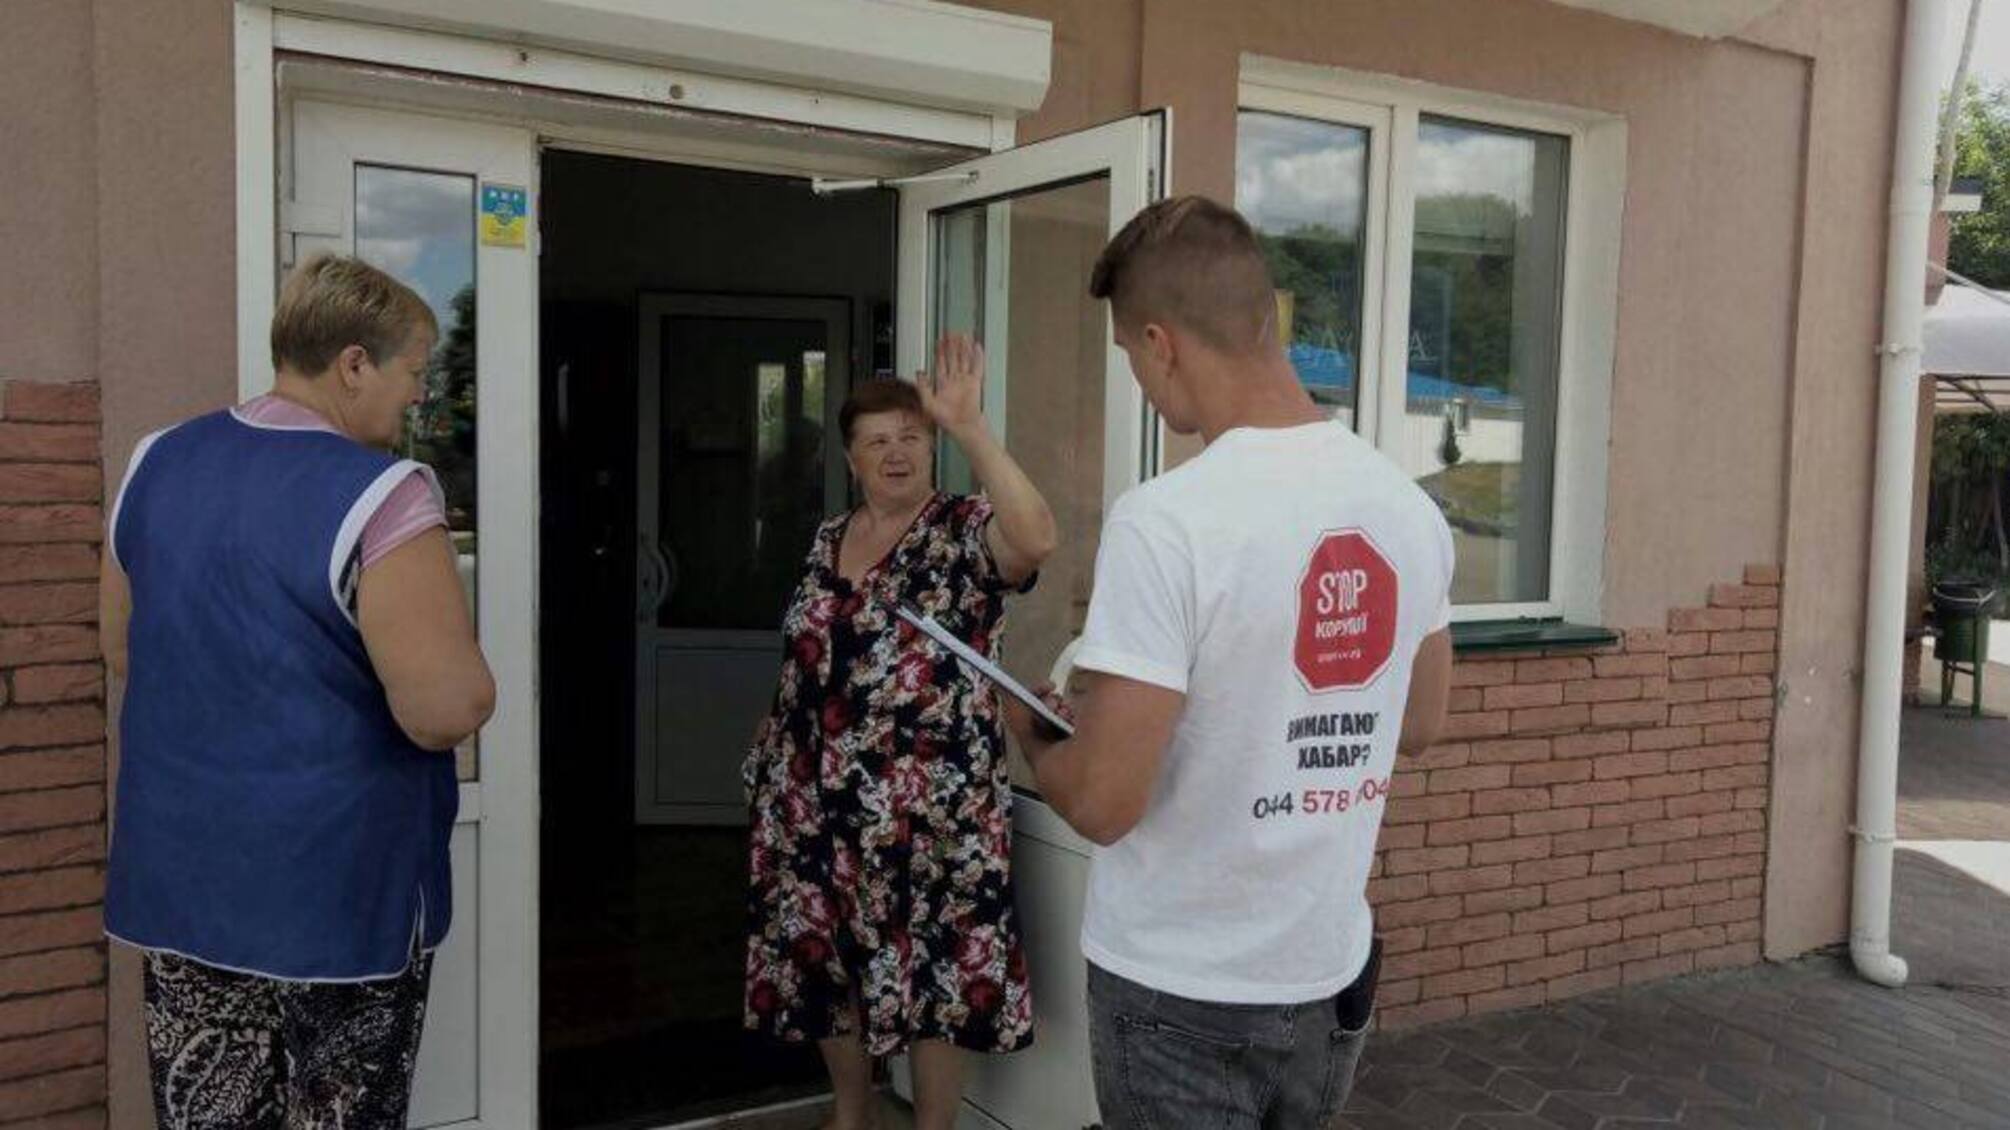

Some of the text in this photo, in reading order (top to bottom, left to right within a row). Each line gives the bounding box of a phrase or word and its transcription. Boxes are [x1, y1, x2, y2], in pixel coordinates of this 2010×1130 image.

[1317, 569, 1367, 614] STOP
[1286, 711, 1380, 742] ВИМАГАЮ
[1302, 790, 1350, 814] 578
